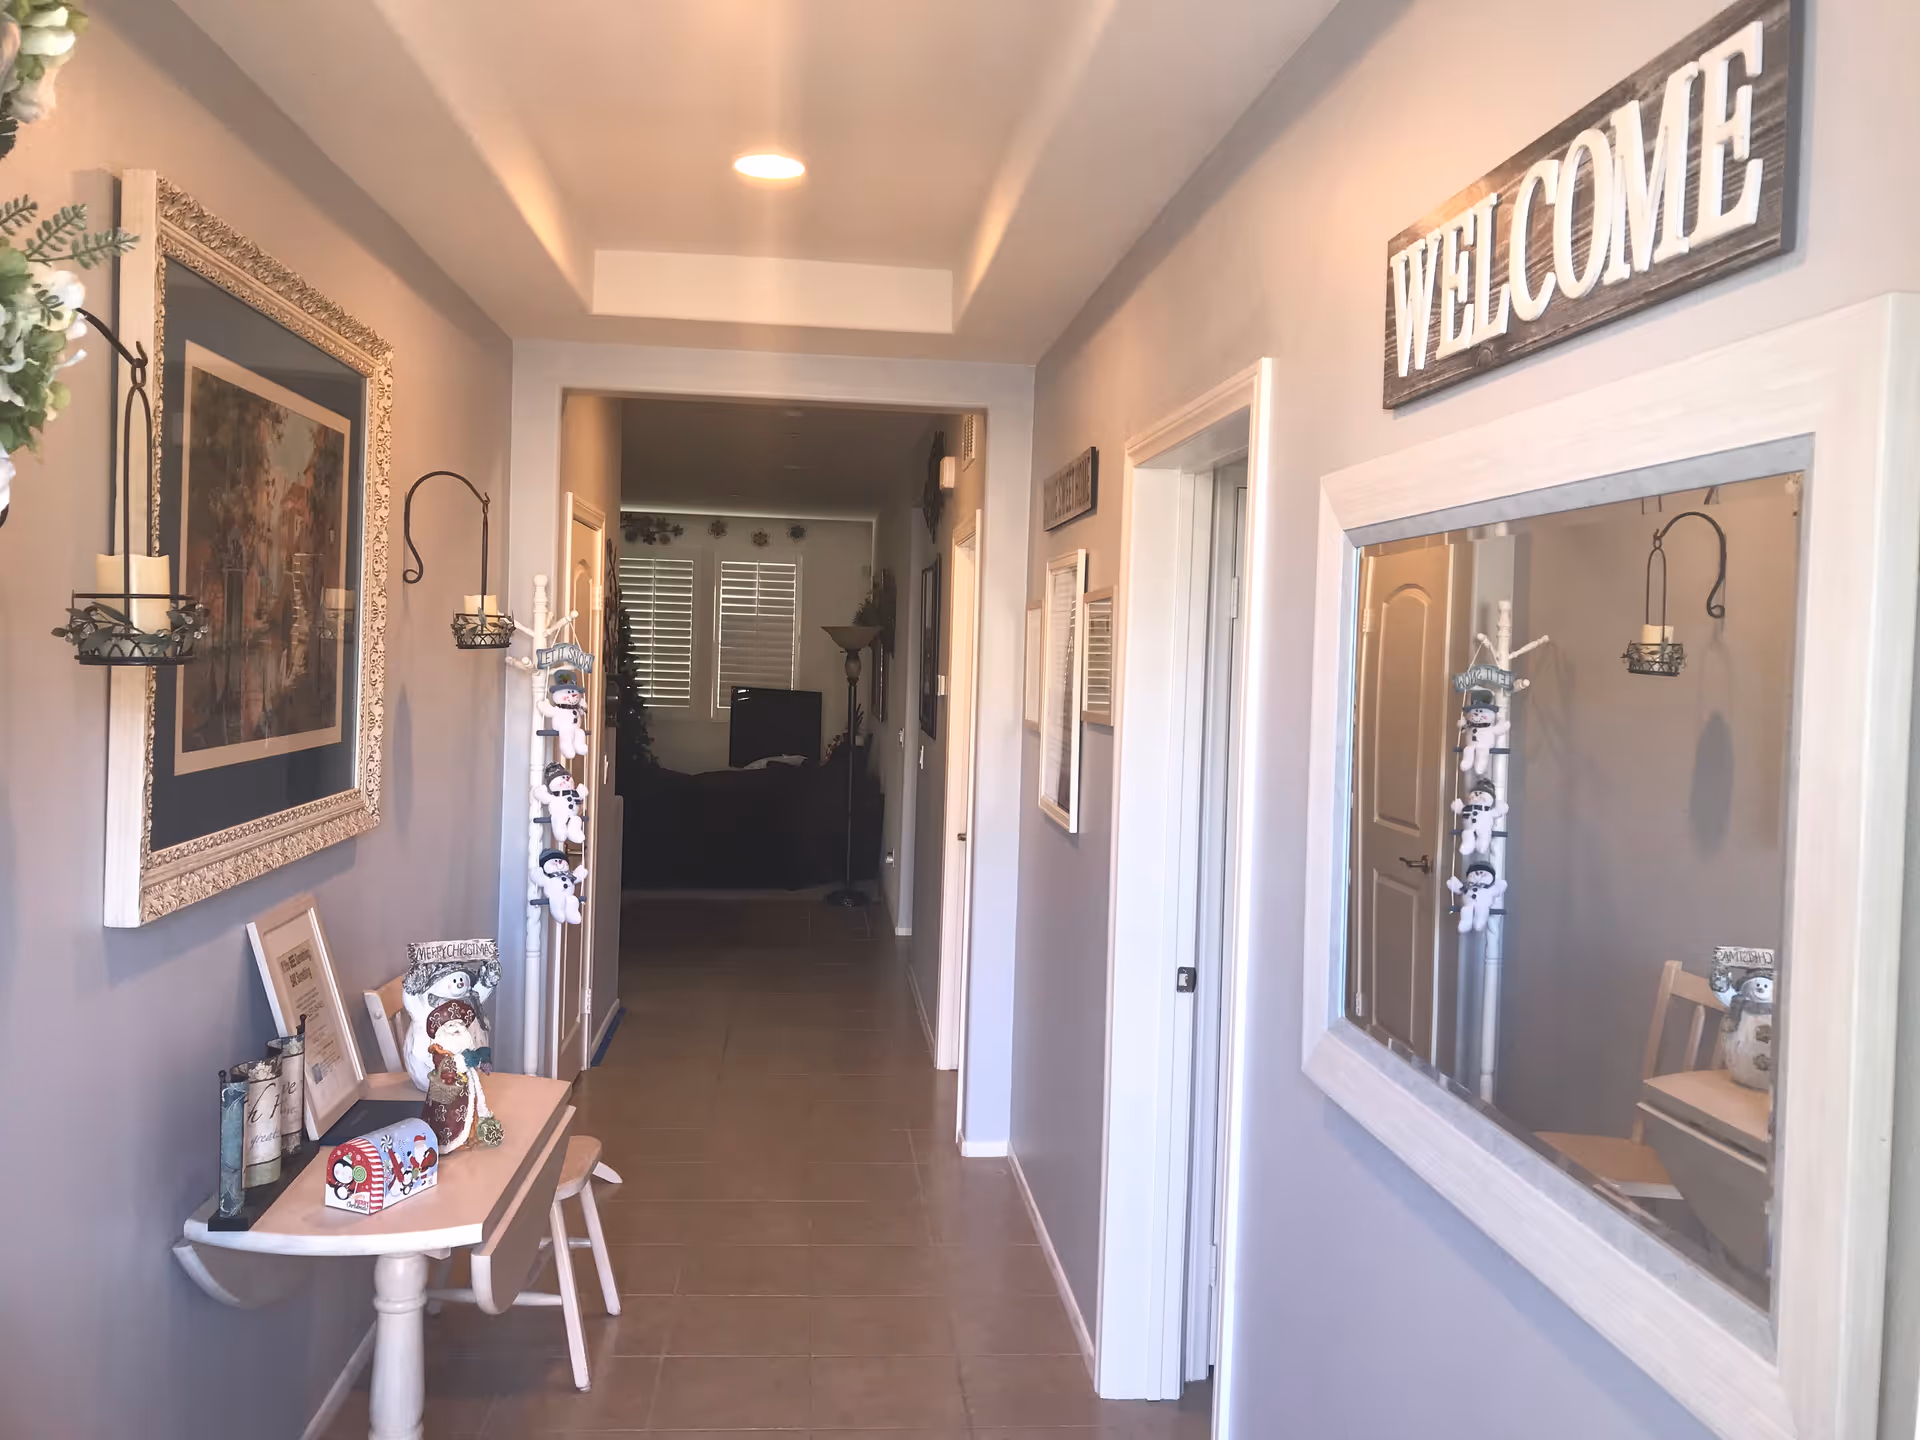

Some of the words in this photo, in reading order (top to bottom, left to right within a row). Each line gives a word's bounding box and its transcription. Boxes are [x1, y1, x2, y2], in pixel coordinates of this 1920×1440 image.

[1390, 20, 1763, 378] WELCOME
[539, 649, 556, 665] LET
[557, 646, 567, 661] IT
[567, 646, 593, 670] SNOW
[415, 945, 447, 961] MERRY
[446, 942, 495, 958] CHRISTMAS
